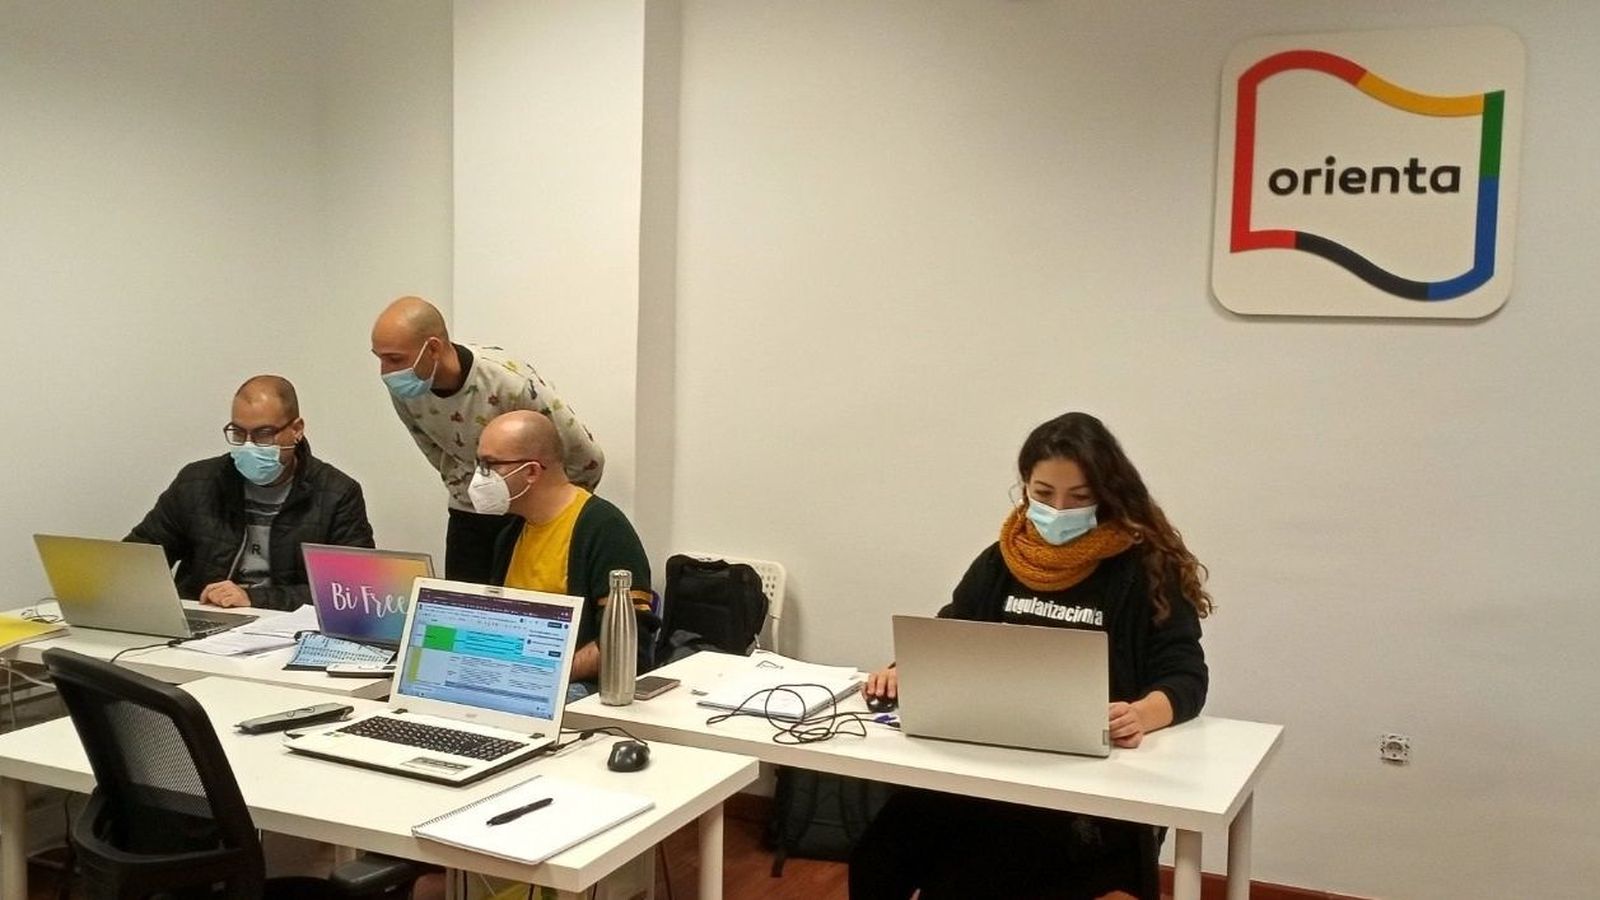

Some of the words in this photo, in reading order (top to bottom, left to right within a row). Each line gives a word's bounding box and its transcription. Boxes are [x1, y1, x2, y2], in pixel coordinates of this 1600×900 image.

[1268, 156, 1461, 196] orienta
[331, 582, 358, 611] Bi
[361, 585, 409, 618] Free
